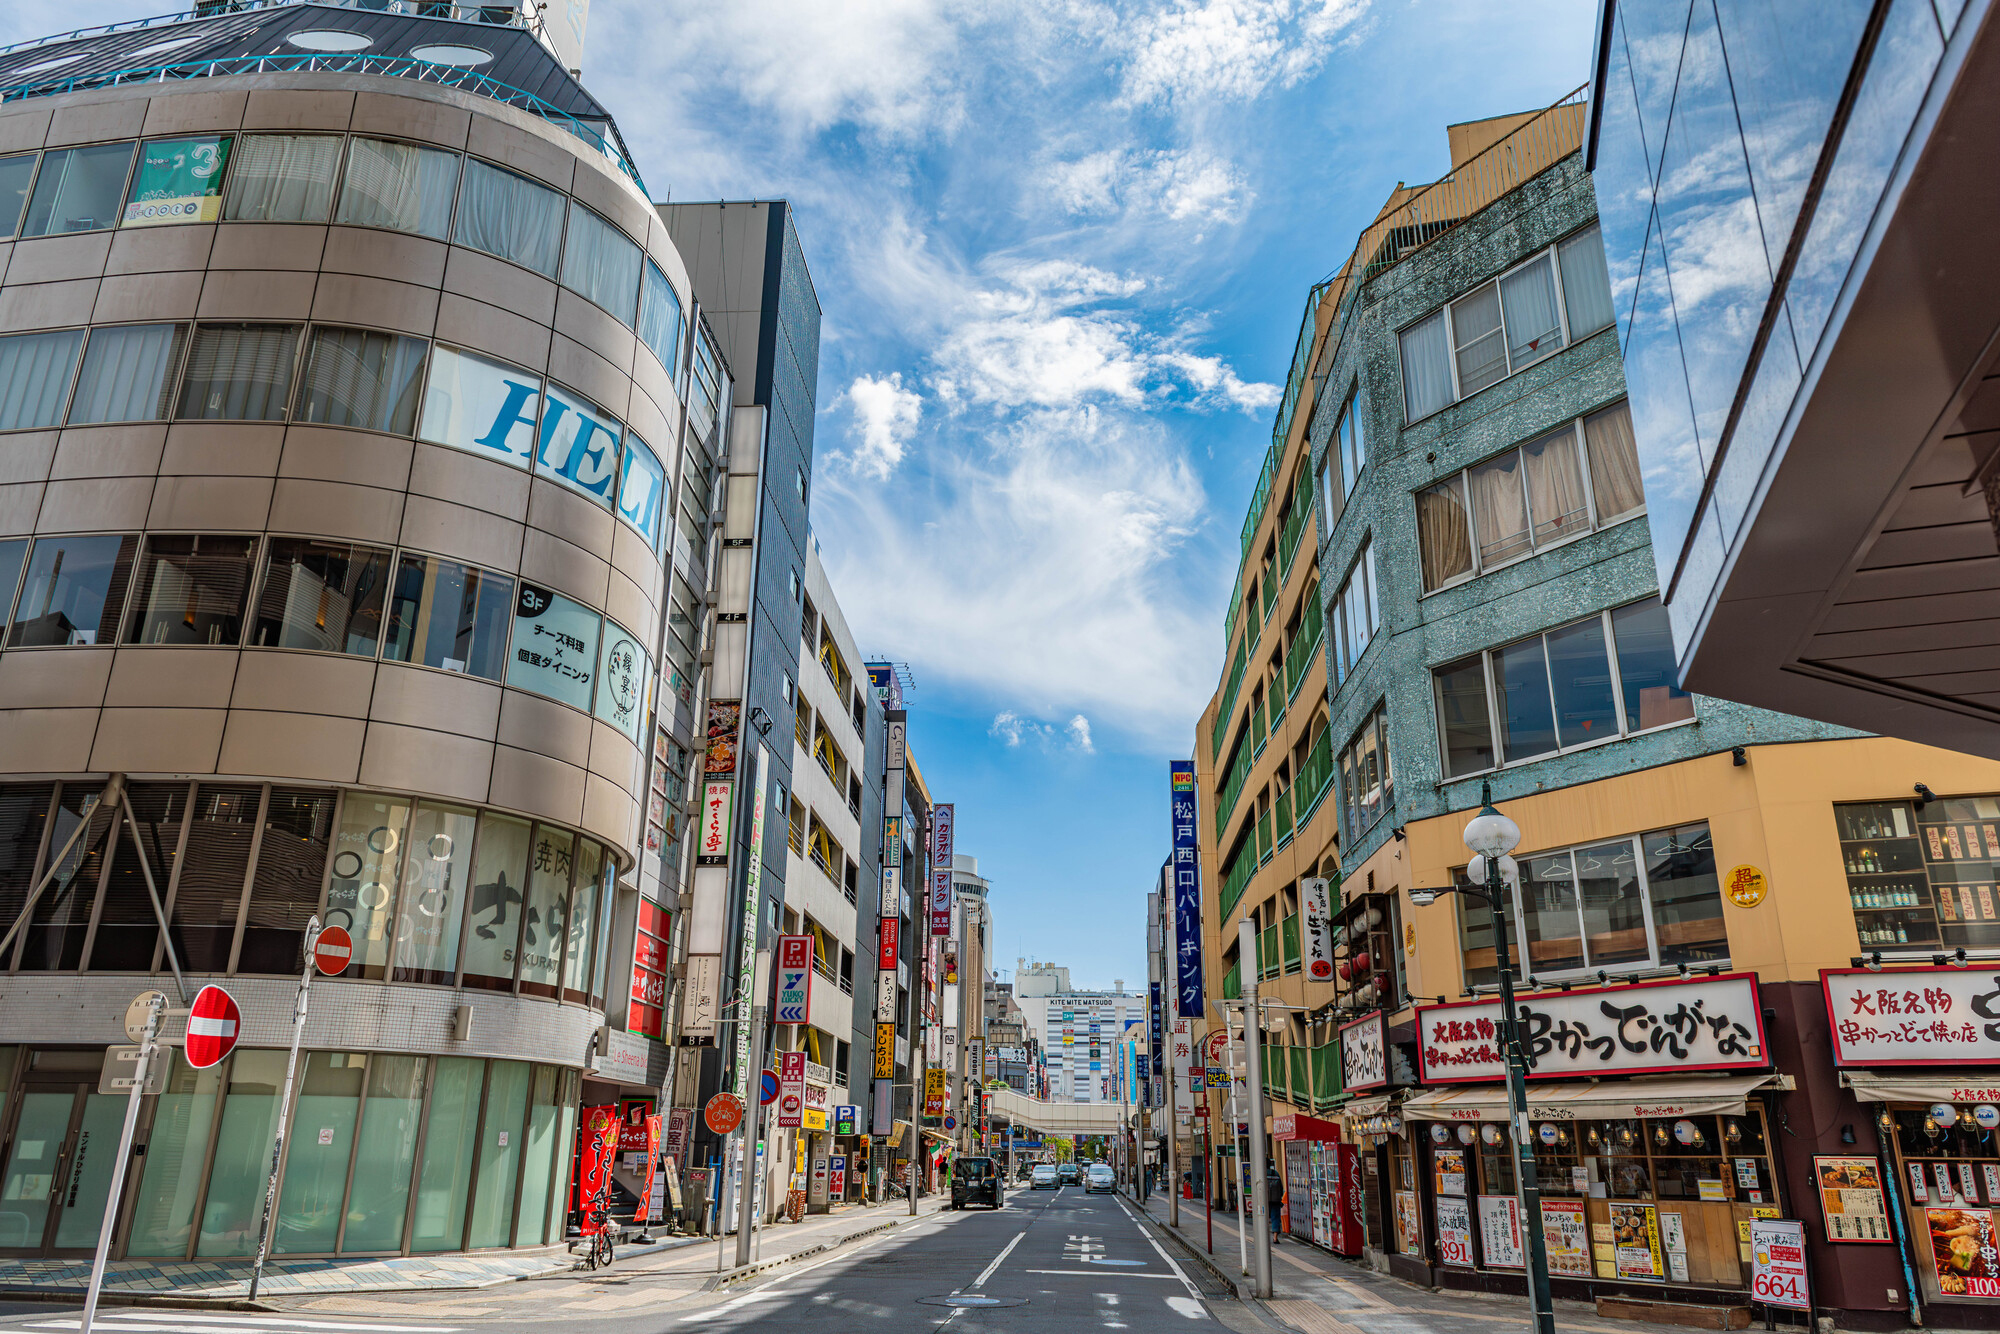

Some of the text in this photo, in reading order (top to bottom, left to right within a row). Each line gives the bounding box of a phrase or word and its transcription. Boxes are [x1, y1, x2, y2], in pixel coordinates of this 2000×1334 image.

[522, 589, 543, 611] 3F
[534, 624, 585, 654] チーズ料理
[518, 648, 590, 684] 個室ダイニング
[1174, 773, 1191, 783] NPC
[708, 786, 729, 795] 焼肉
[706, 798, 724, 851] さくら亭
[937, 824, 949, 863] カラオケ
[706, 856, 719, 864] 2F
[936, 874, 947, 904] マック
[1175, 801, 1199, 1004] 松戸西口パーキング
[790, 943, 801, 954] P
[781, 990, 804, 998] YUKO
[781, 996, 804, 1004] LUCKY
[1850, 987, 1952, 1016] 大阪名物
[1432, 1017, 1495, 1044] 大阪名物
[1517, 1000, 1752, 1069] 串かつでんがな
[1838, 1019, 1979, 1046] 串かつとどて焼の店
[689, 1036, 705, 1045] BF
[789, 1056, 798, 1067] P
[839, 1107, 851, 1120] P
[1450, 1110, 1481, 1119] 大阪名物
[1533, 1108, 1575, 1119] 串かつでんがな
[1634, 1106, 1685, 1117] 串かつとどて焼の店
[832, 1158, 843, 1169] P
[831, 1171, 843, 1183] 24
[1545, 1213, 1572, 1223] めっちゃ
[1561, 1223, 1585, 1234] 特割り
[1753, 1232, 1788, 1245] ちょい飲み
[1755, 1274, 1800, 1299] 664
[1972, 1278, 1998, 1296] 100
